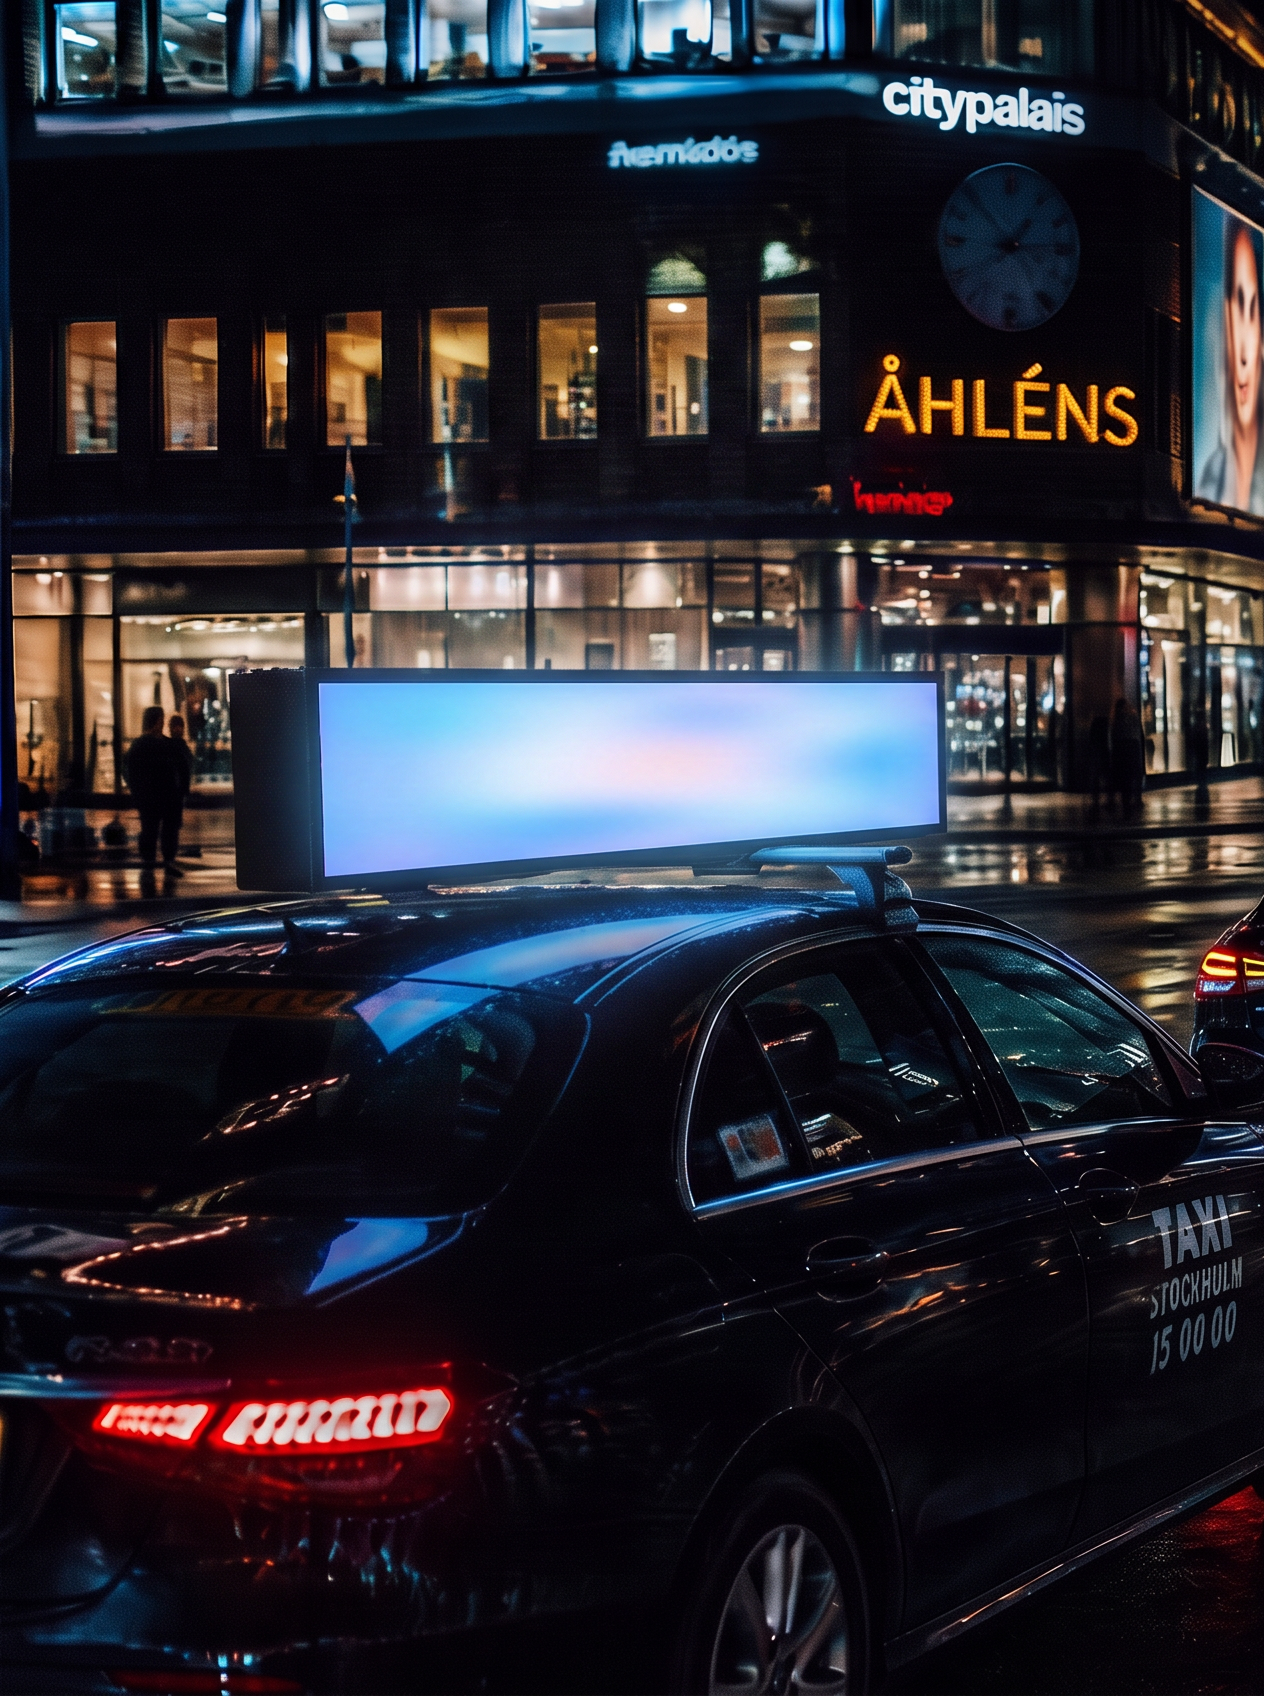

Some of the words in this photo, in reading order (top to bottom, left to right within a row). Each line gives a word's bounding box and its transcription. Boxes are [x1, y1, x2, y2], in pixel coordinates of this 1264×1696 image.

[882, 76, 1086, 135] citypalais
[864, 354, 1139, 446] ÅHLÉNS
[1151, 1194, 1233, 1270] TAXI
[1150, 1324, 1173, 1375] 15
[1179, 1313, 1205, 1362] 00
[1211, 1300, 1237, 1349] 00
